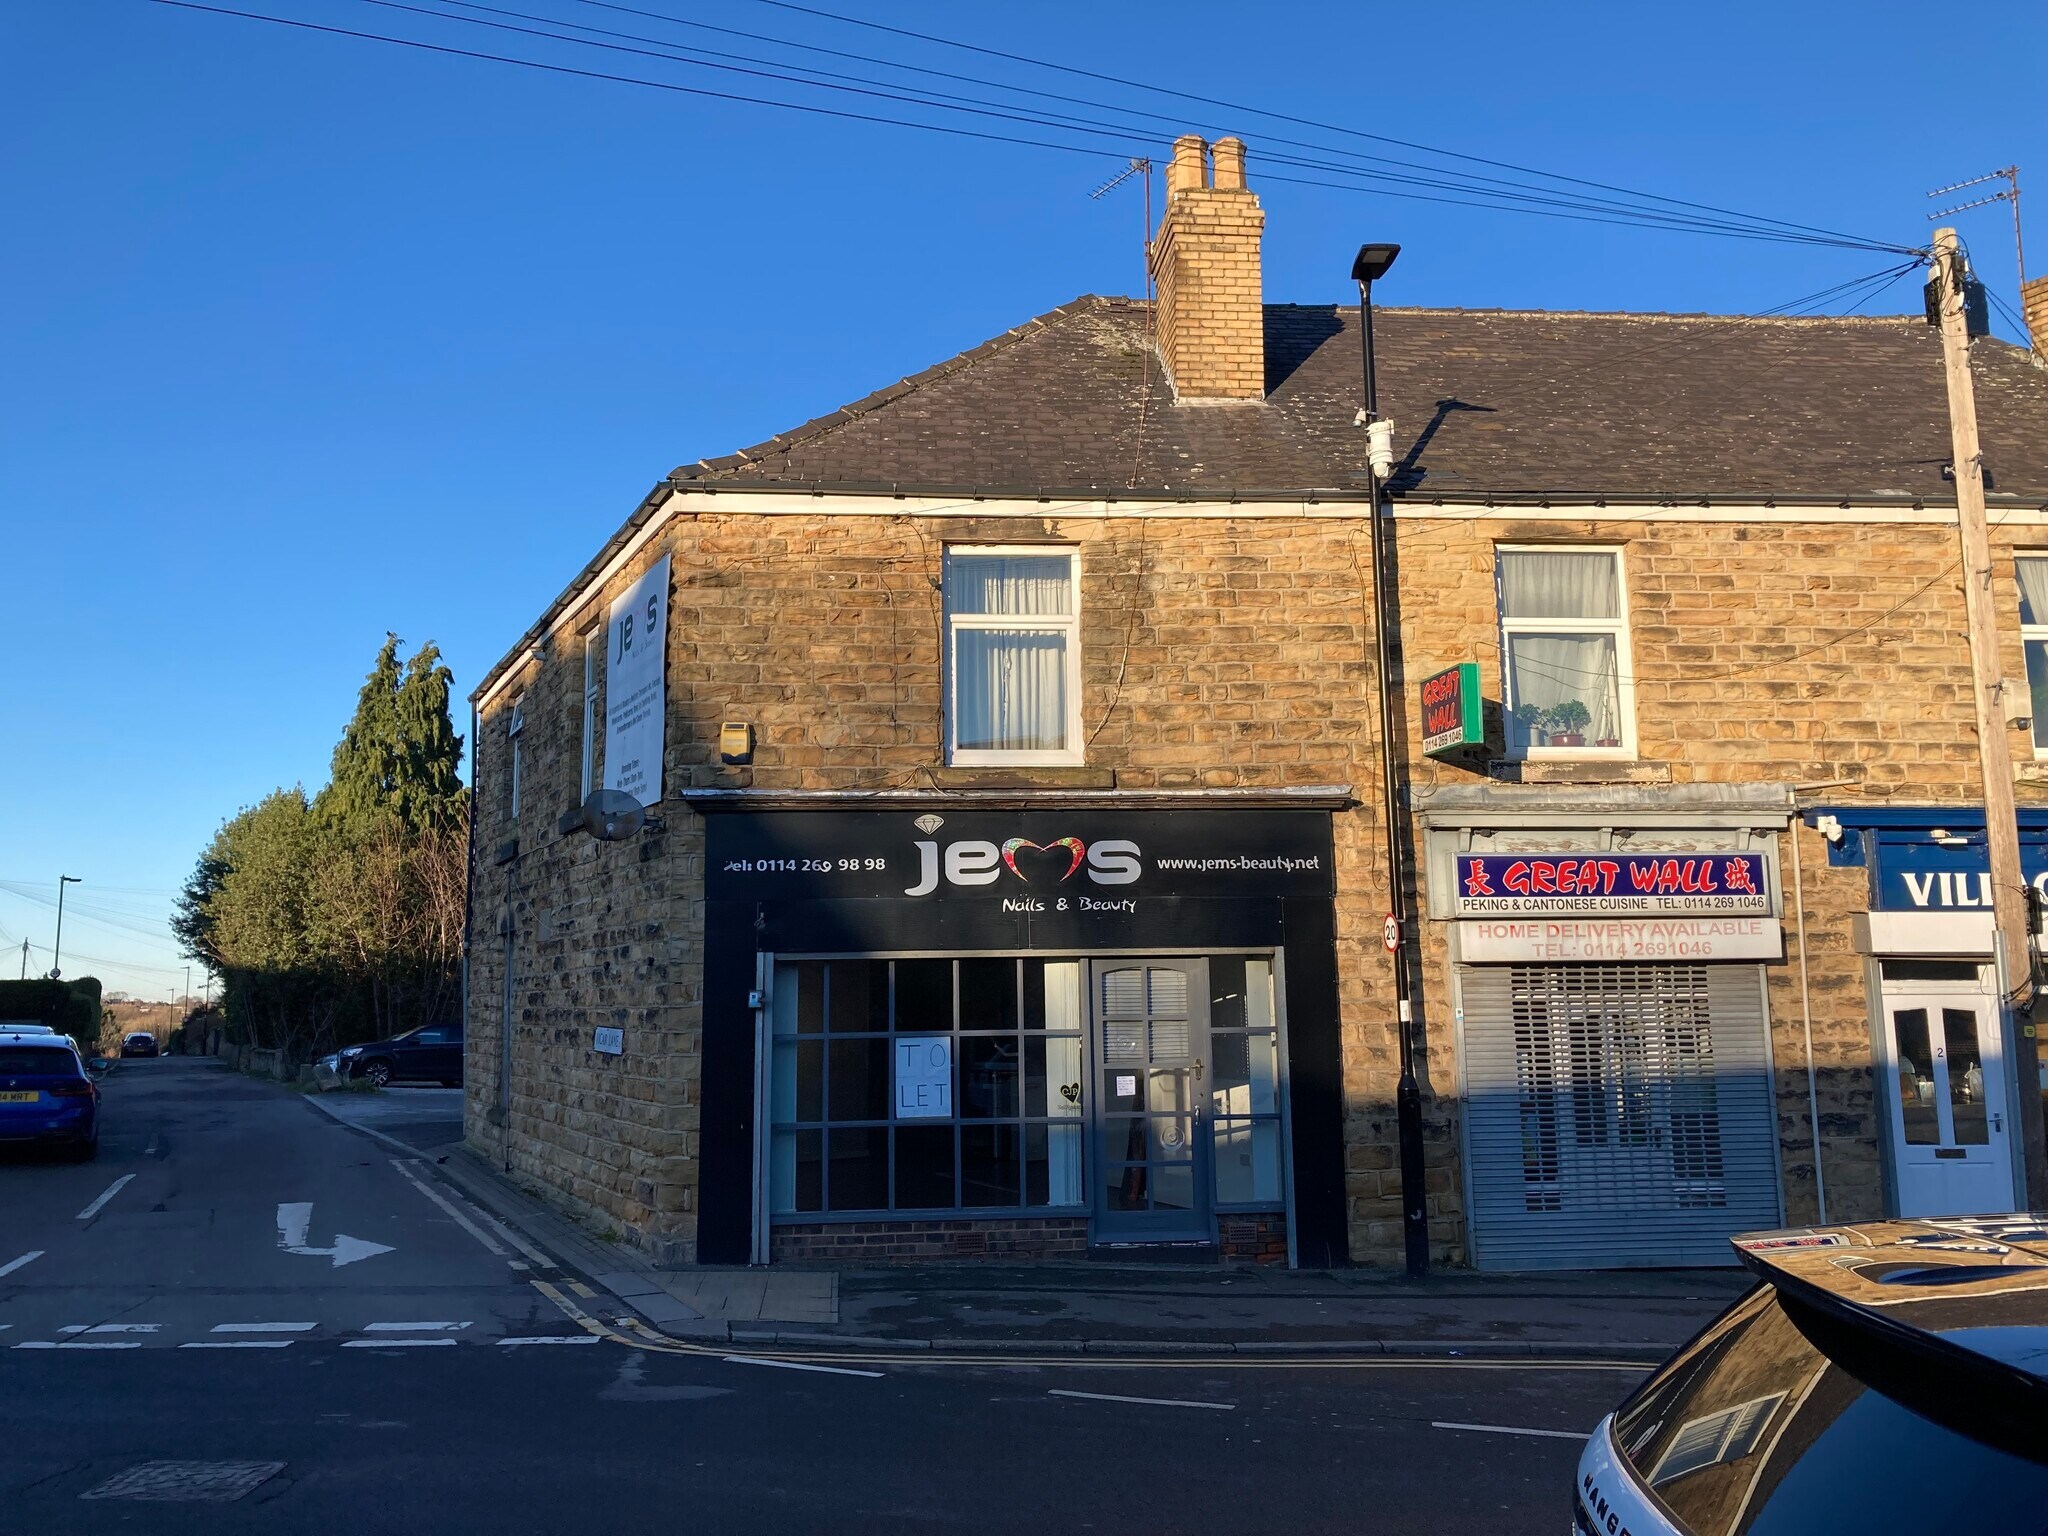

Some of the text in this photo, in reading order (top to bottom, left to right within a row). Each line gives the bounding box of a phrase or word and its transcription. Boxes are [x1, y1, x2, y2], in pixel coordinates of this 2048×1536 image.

[1423, 670, 1459, 707] GREAT
[1428, 701, 1457, 734] WALL
[1425, 729, 1462, 751] 0114 269 1046
[756, 859, 797, 872] 0114
[801, 859, 832, 873] 269
[838, 858, 860, 871] 98
[864, 858, 886, 870] 98
[1157, 856, 1320, 872] www.jems-beauty.net
[1464, 859, 1495, 896] 長
[1503, 859, 1718, 895] GREAT WALL
[1002, 896, 1137, 913] Nails & Beauty
[1463, 896, 1764, 911] PEKING & CANTONESE CUISINE TEL: 0114 269 1046
[1385, 924, 1396, 940] 20
[1478, 921, 1762, 939] HOME DELIVERY AVAILABLE
[1532, 942, 1712, 957] TEL: 0114 2691046
[900, 1044, 946, 1068] TO
[1937, 1047, 1944, 1058] 2
[901, 1083, 947, 1107] LET
